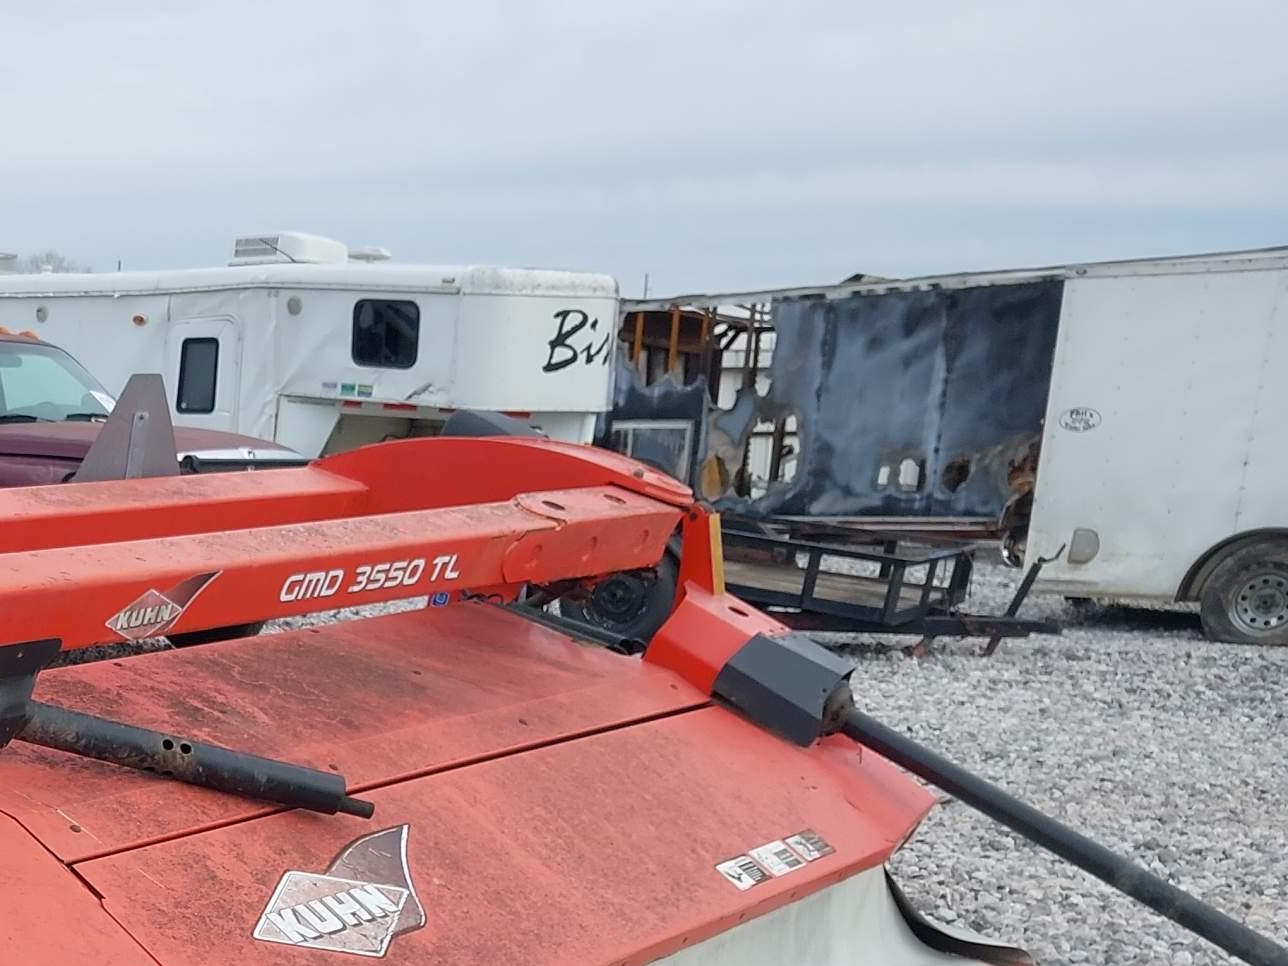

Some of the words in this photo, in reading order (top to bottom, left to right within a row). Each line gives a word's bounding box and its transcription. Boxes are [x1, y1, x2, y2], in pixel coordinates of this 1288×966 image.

[279, 568, 345, 602] GMD
[347, 558, 425, 593] 3550
[430, 553, 460, 583] TL
[116, 603, 172, 630] KUHN
[265, 884, 401, 944] KUHN
